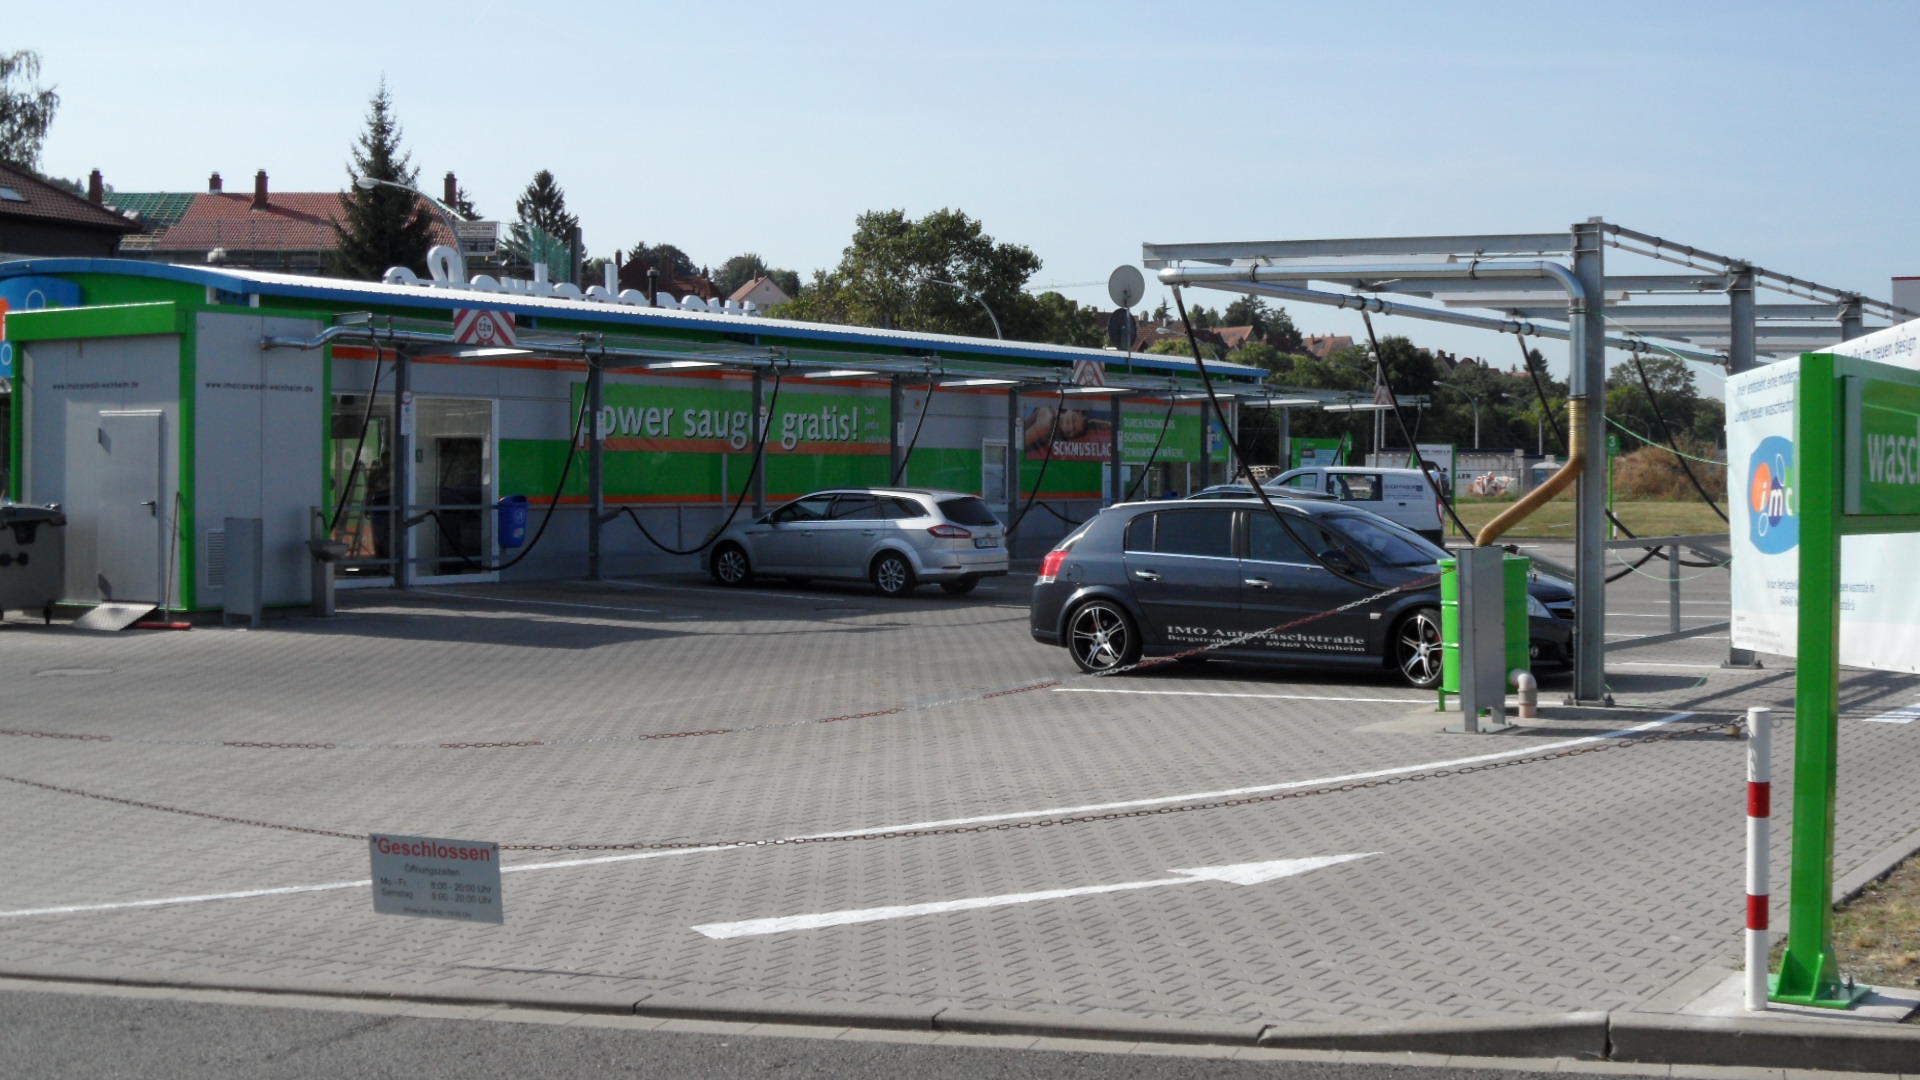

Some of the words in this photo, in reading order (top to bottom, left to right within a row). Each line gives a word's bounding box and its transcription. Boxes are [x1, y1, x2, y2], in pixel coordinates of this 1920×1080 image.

[782, 405, 858, 451] gratis!
[1053, 440, 1112, 458] SCHMUSELAC
[1167, 626, 1208, 635] IMO
[1168, 634, 1231, 643] Bergstraß
[1304, 643, 1365, 652] Weinheim
[377, 837, 491, 862] Geschlossen
